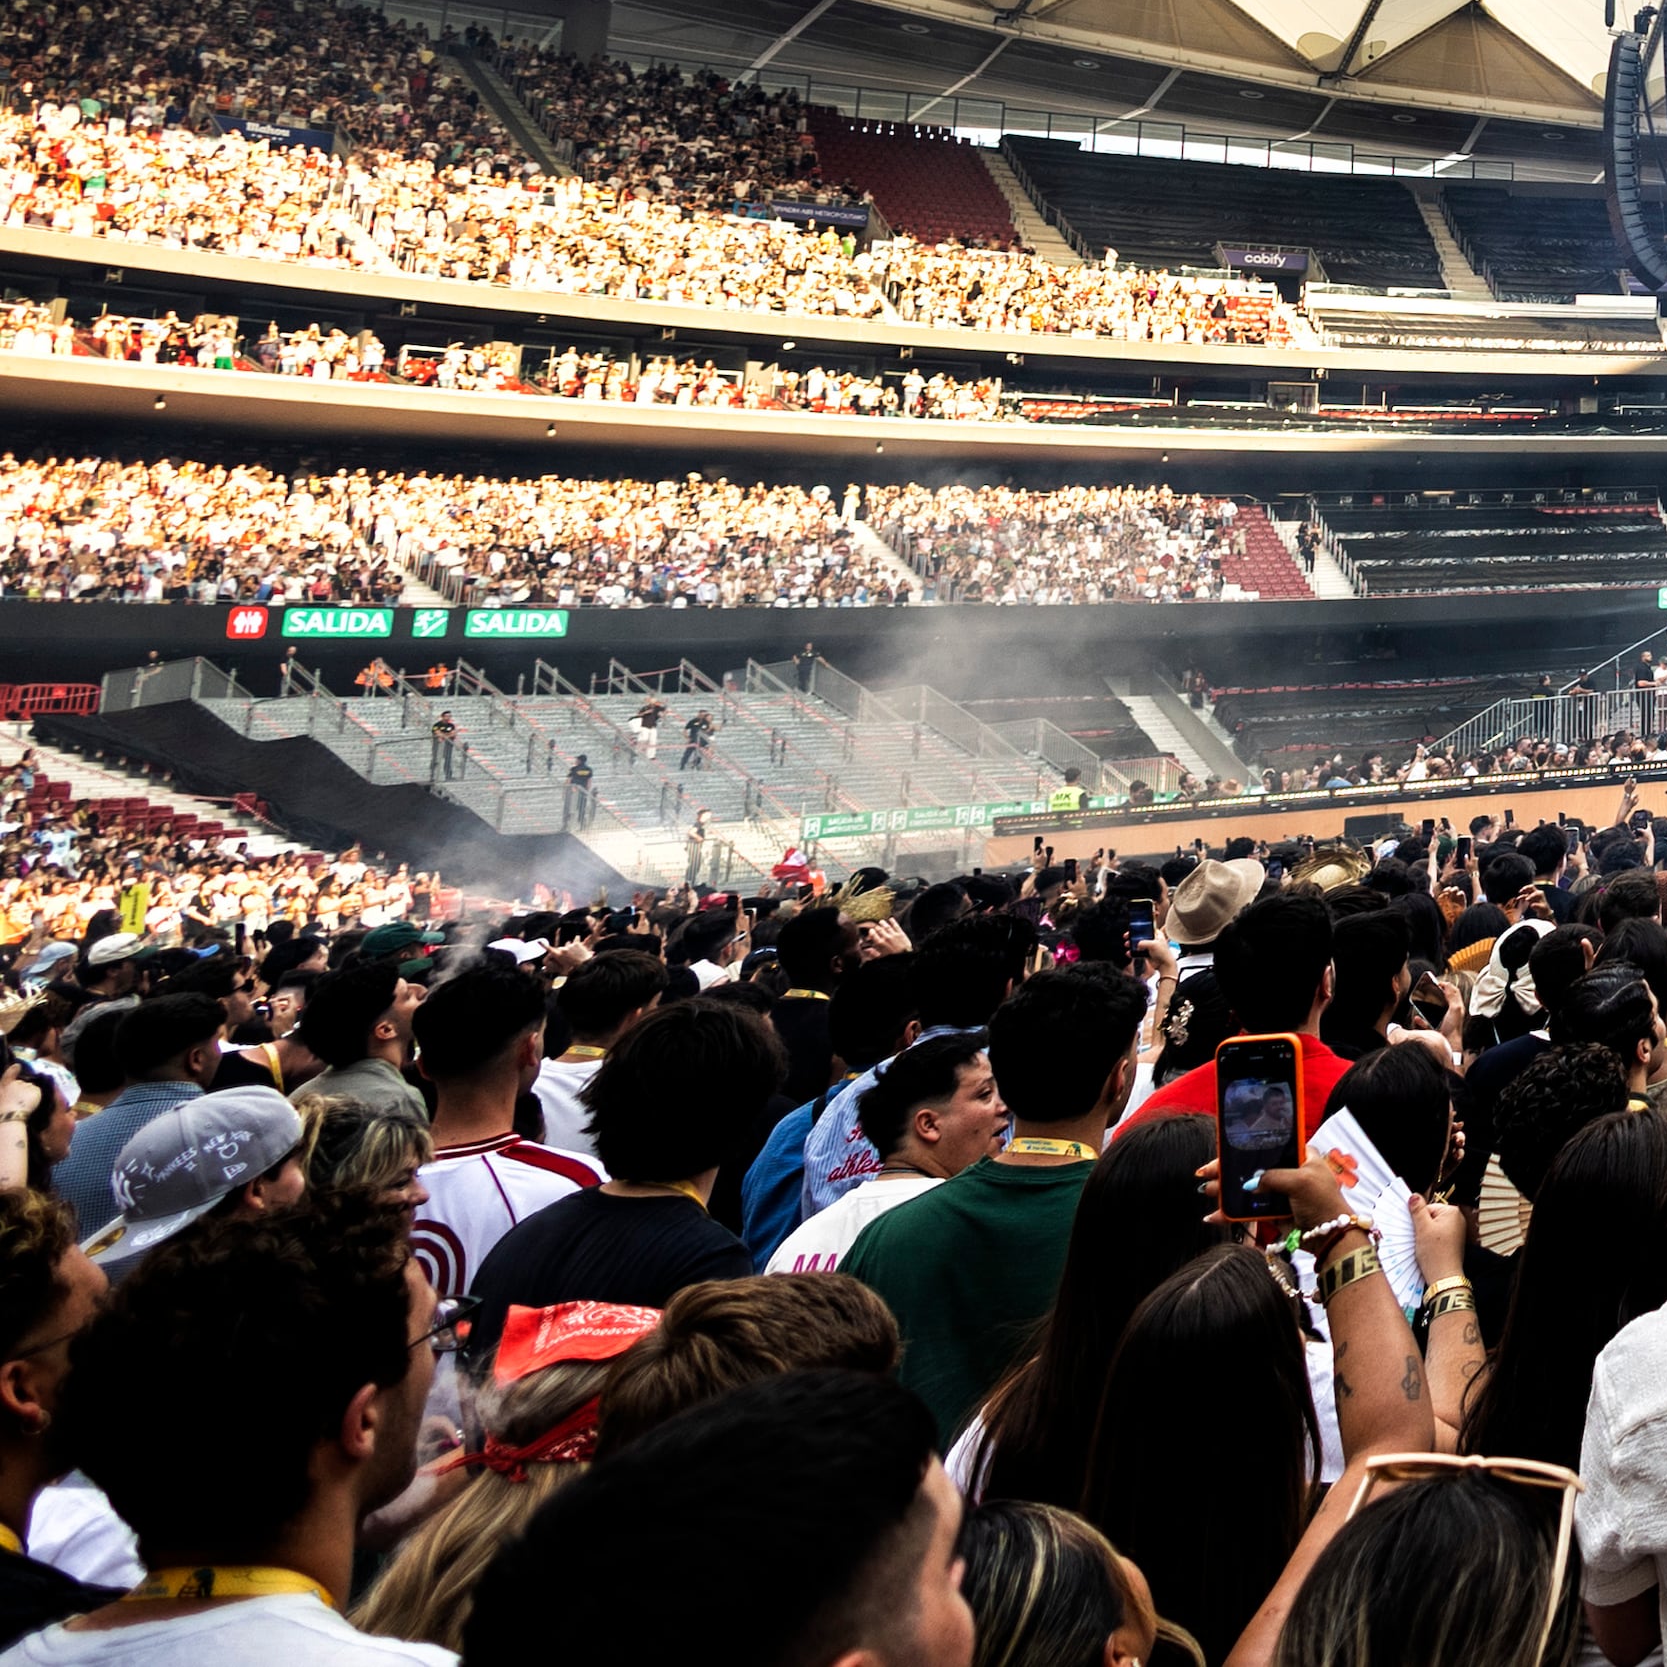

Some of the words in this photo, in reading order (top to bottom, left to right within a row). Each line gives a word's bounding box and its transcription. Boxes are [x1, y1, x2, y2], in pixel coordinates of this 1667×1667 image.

[1244, 253, 1287, 268] cabify
[288, 611, 388, 634] SALIDA
[470, 612, 563, 634] SALIDA
[153, 1146, 198, 1183] YANKEES
